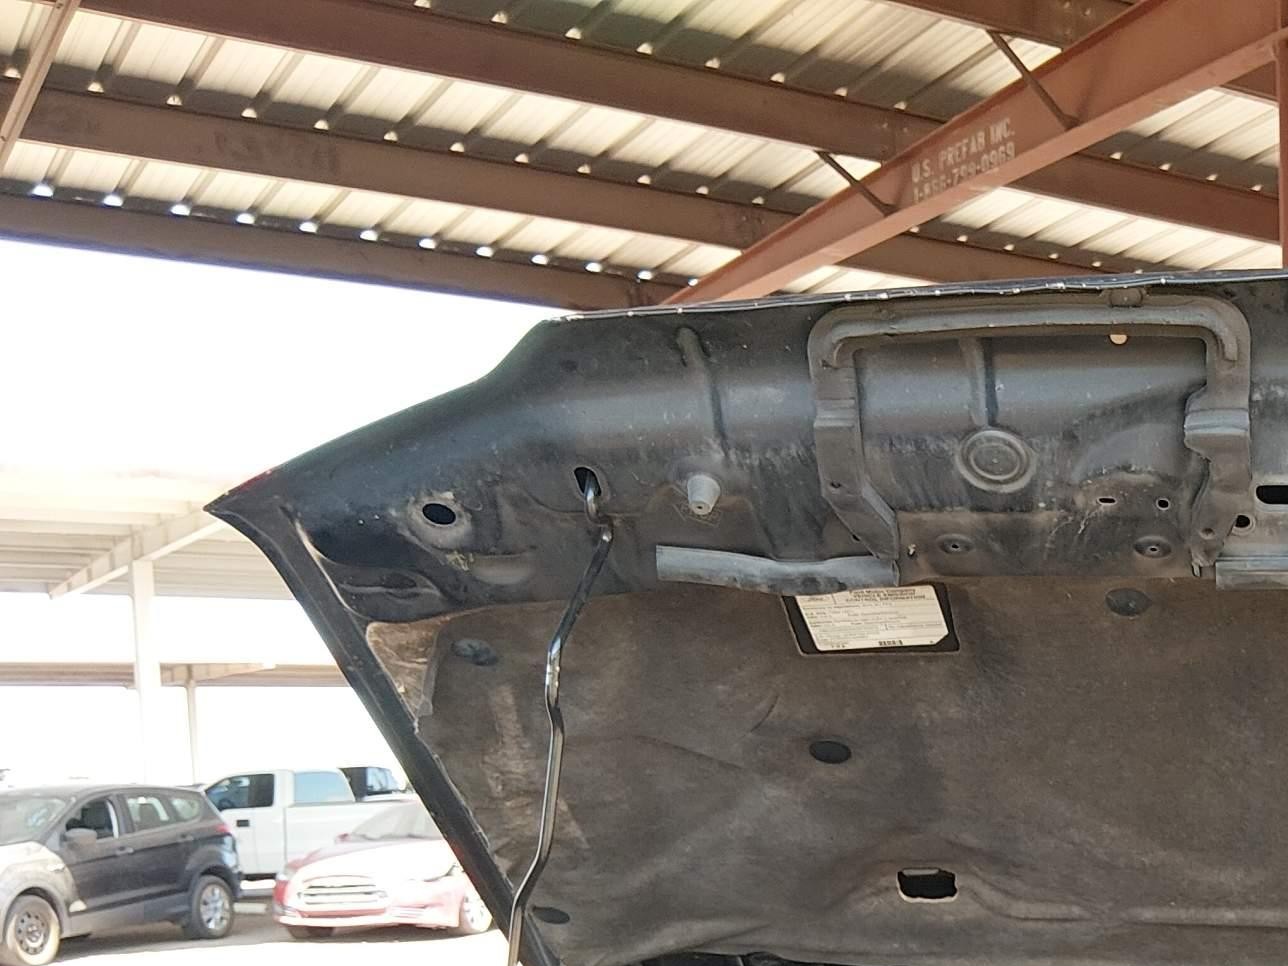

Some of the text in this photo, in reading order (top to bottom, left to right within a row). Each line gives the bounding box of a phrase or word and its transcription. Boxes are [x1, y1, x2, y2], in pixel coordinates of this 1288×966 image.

[912, 117, 1015, 183] U.S. PREFAB INC.
